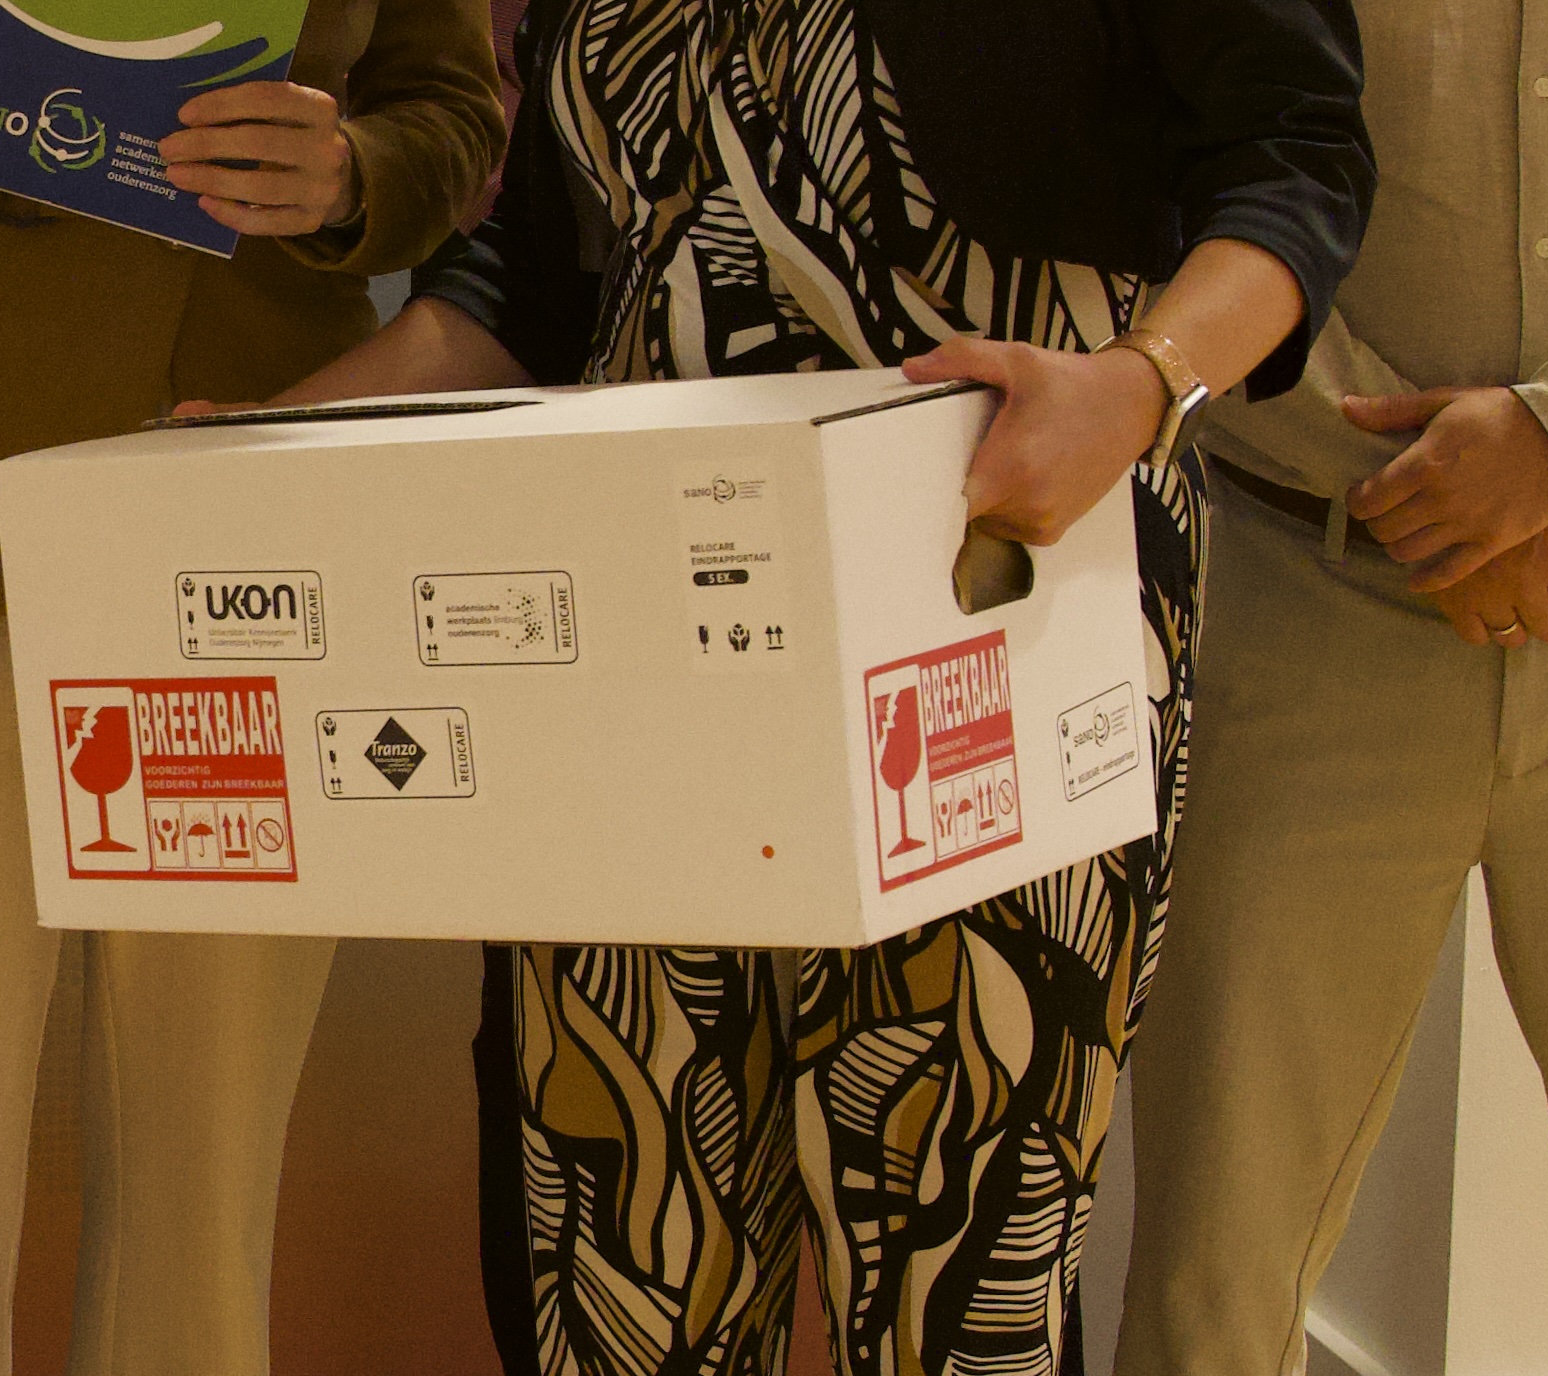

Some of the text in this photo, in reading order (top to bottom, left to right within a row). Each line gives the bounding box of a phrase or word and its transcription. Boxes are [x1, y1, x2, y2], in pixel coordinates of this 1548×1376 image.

[107, 171, 178, 201] ouderenzorg
[307, 586, 321, 645] RELOCARE
[557, 587, 572, 649] RELOCARE
[920, 644, 1011, 737] BREEKBAAR
[135, 690, 282, 756] BREEKBAAR
[371, 740, 417, 757] Tranzo
[454, 723, 470, 782] RELOCARE
[144, 765, 211, 776] VOORZICHTIG
[144, 778, 284, 790] GOEDEREN ZIJN BREEKBAAR
